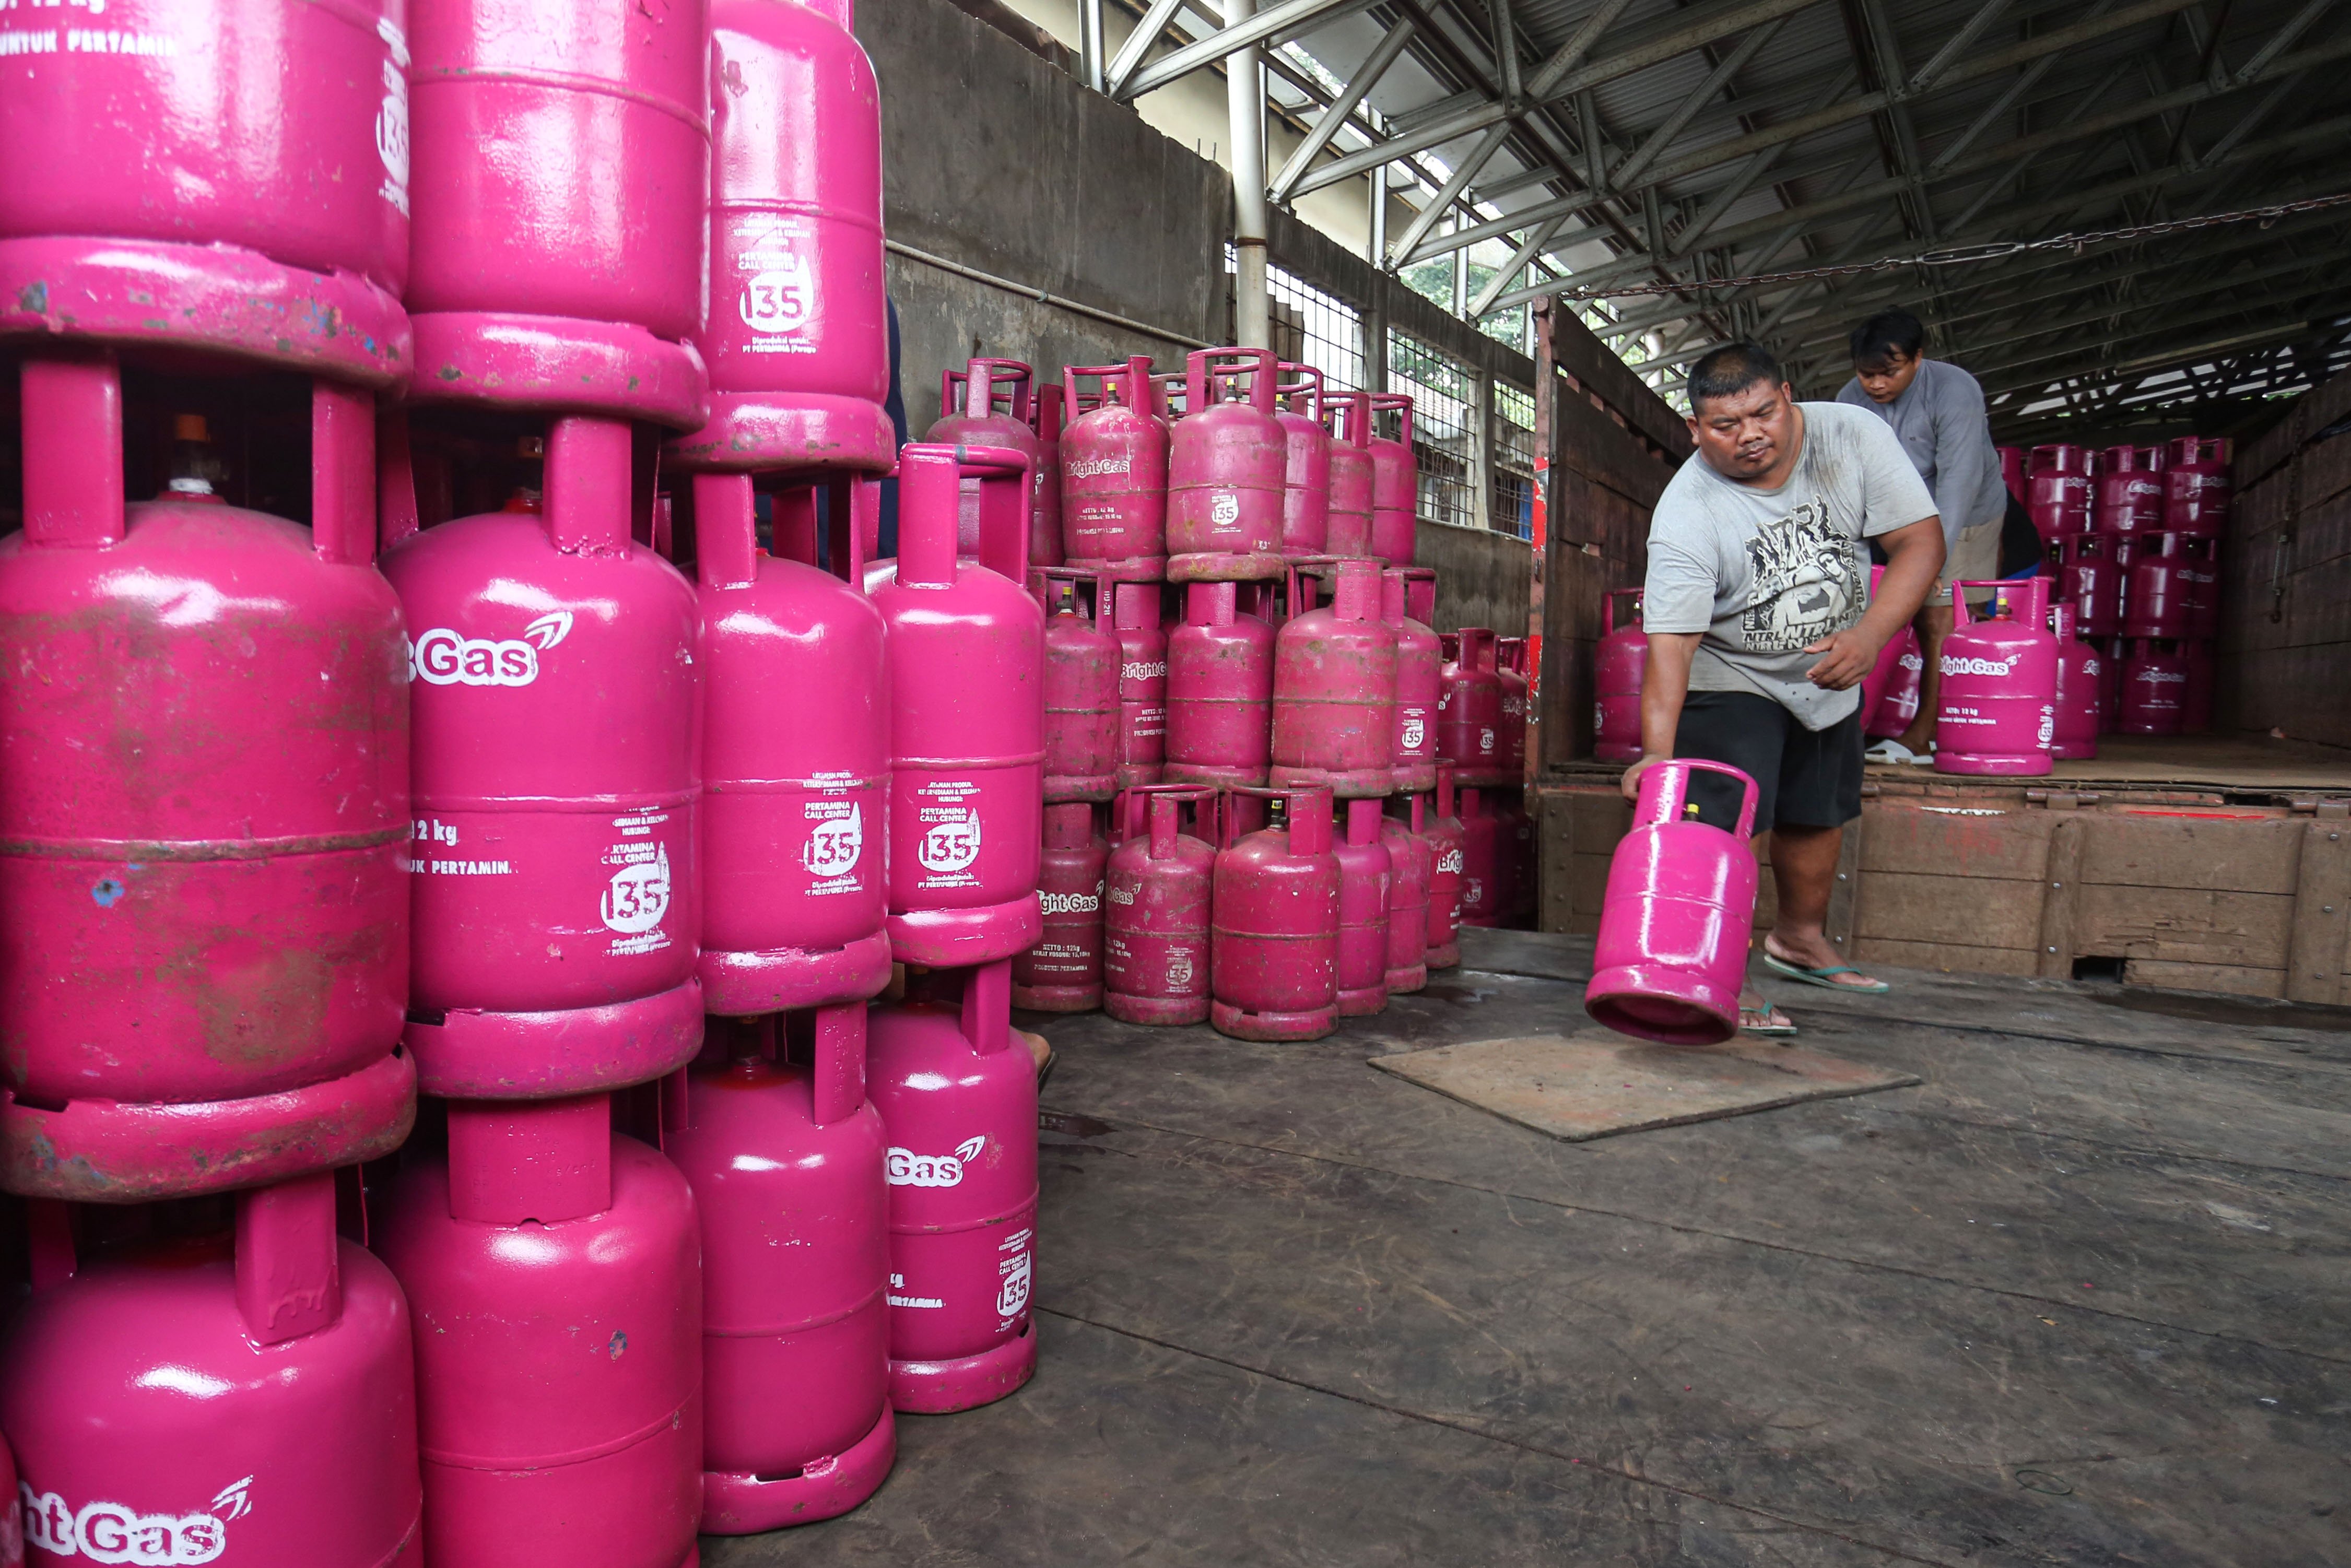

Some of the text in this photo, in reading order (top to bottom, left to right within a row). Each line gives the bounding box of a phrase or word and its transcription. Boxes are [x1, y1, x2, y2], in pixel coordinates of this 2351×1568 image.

[67, 29, 178, 56] PERTAMIN
[744, 285, 803, 319] 135
[1214, 507, 1234, 520] 135
[415, 628, 538, 687] Gas
[1970, 657, 2009, 676] Gas
[1404, 731, 1420, 742] 135
[804, 810, 850, 819] CALL CENTER
[805, 801, 850, 810] PERTAMINA
[433, 819, 457, 846] kg
[611, 841, 655, 854] RTAMINA
[808, 833, 854, 865] 135
[923, 835, 970, 862] 135
[432, 860, 518, 874] PERTAMIN
[625, 852, 655, 863] CENTER
[606, 879, 665, 919] 135
[1068, 893, 1098, 913] Gas
[1112, 887, 1134, 905] Gas
[888, 1147, 963, 1187] Gas
[1000, 1252, 1026, 1269] PERTAMINA
[999, 1266, 1010, 1276] CALL
[1000, 1274, 1027, 1311] 135
[75, 1504, 225, 1564] Gas
